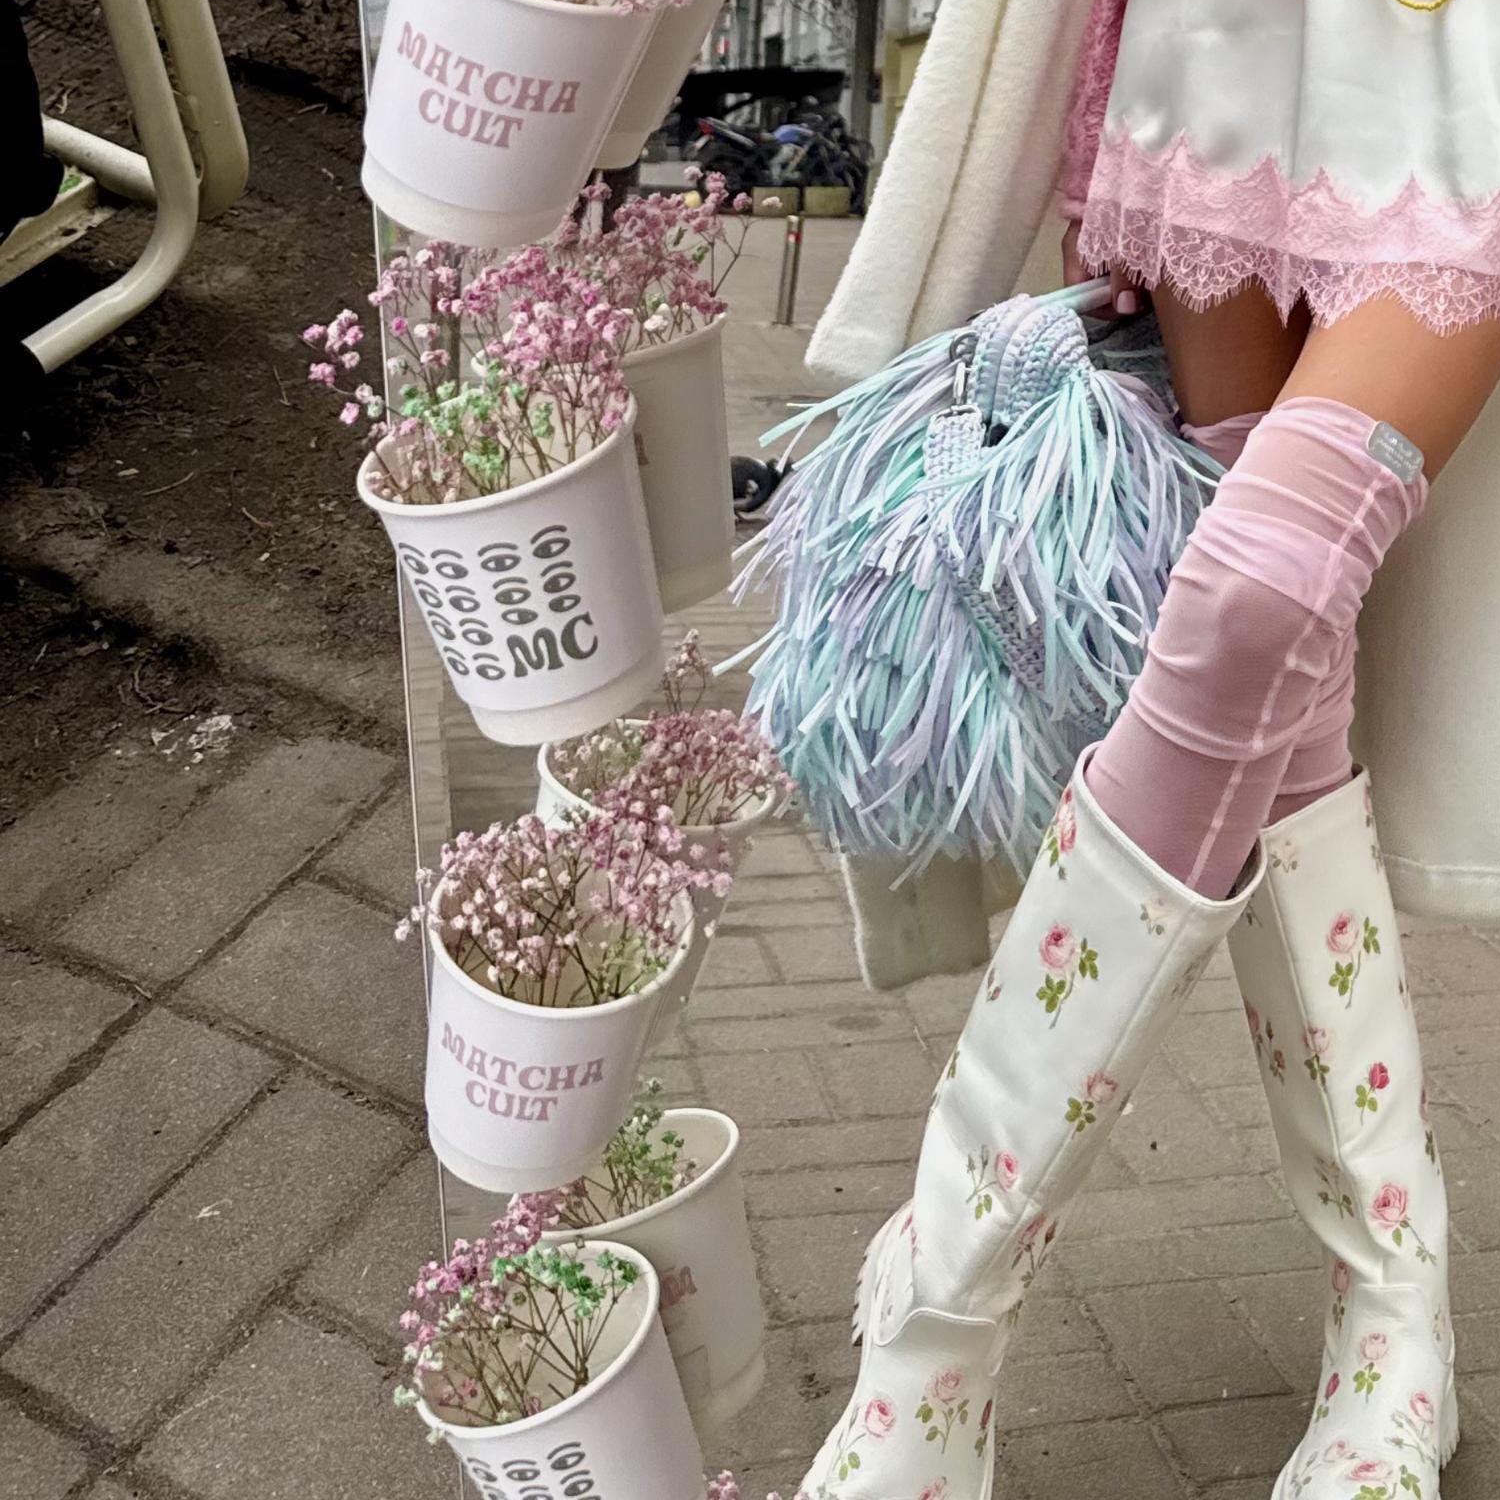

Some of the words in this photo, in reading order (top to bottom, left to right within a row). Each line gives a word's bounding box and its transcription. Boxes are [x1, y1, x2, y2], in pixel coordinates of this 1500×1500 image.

[397, 21, 581, 114] MATCHA
[418, 88, 524, 149] CULT
[506, 612, 599, 678] MC
[441, 1022, 605, 1092] MATCHA
[465, 1079, 559, 1122] CULT
